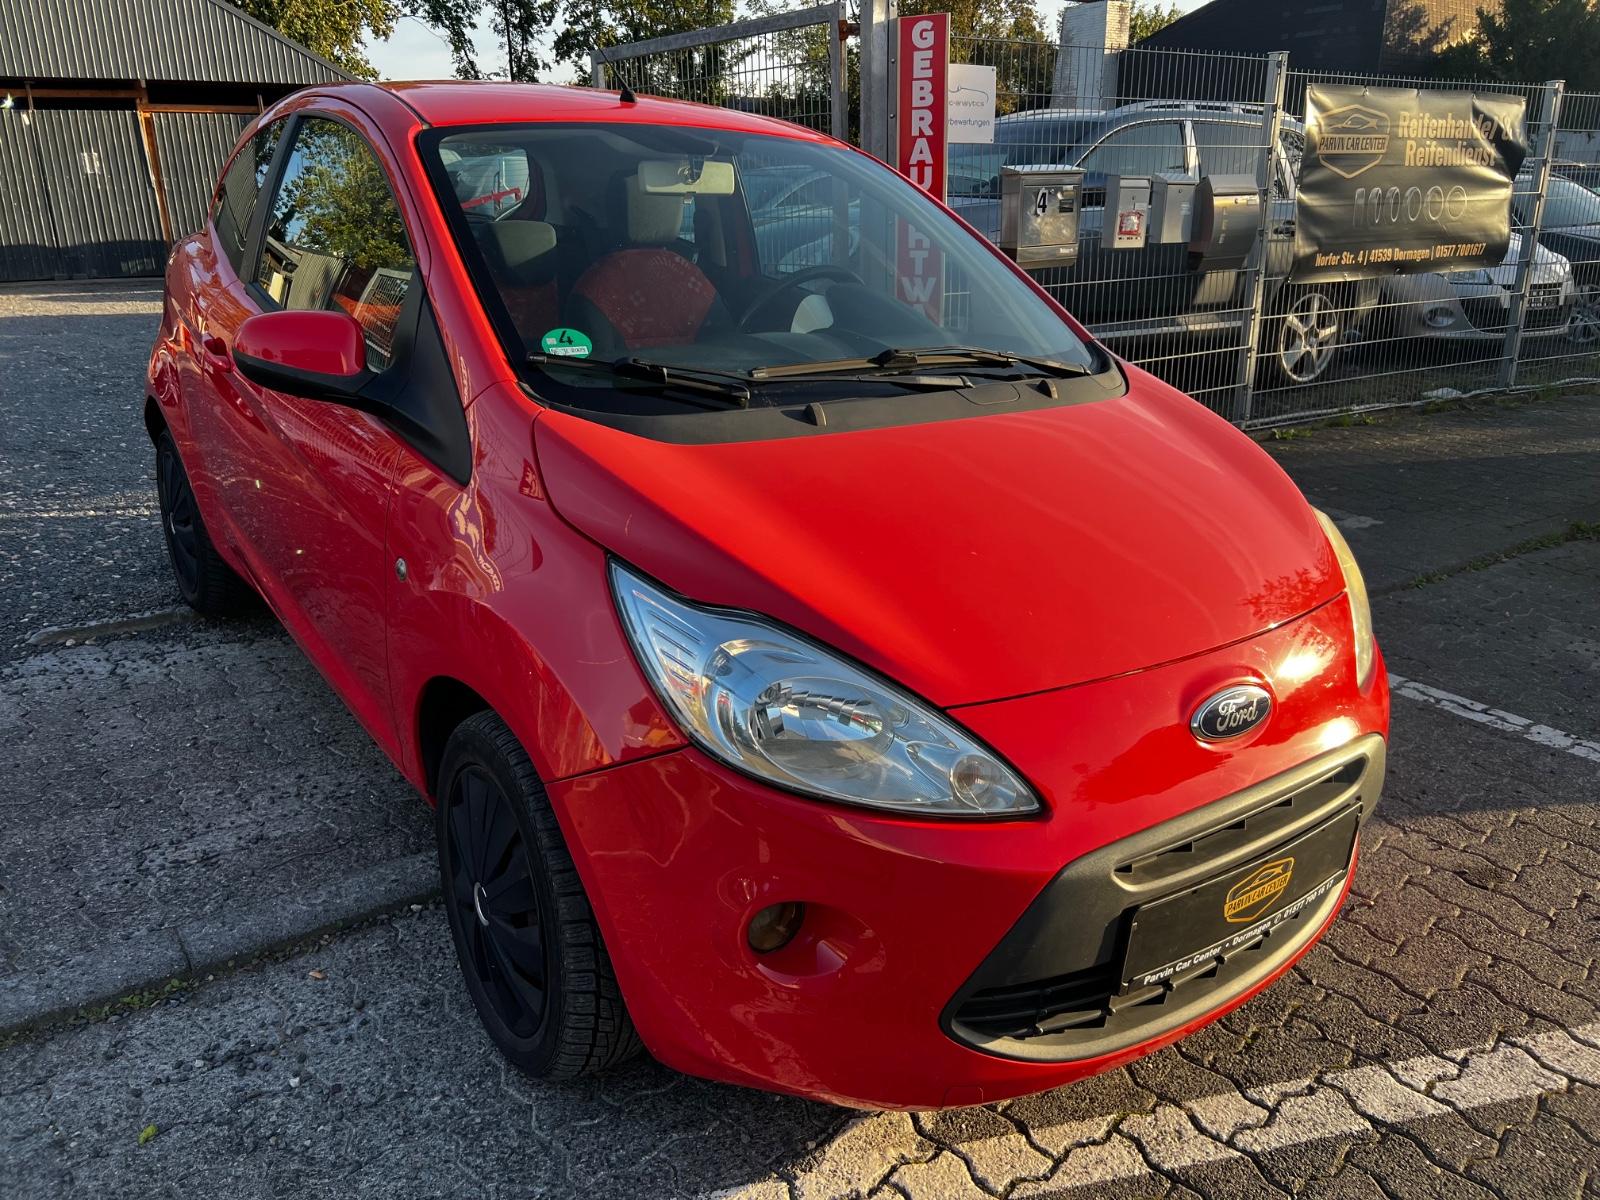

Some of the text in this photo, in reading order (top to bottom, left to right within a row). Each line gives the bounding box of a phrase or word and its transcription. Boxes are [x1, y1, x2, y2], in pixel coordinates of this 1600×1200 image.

[1398, 111, 1497, 140] Reifenhandel
[1319, 137, 1387, 151] PARVIN CAR CENTER
[1404, 140, 1496, 167] Reifendienst
[1037, 191, 1048, 213] 4
[1315, 252, 1340, 267] Norfer
[1341, 250, 1355, 265] Str.
[1358, 250, 1364, 264] 4
[1369, 248, 1392, 263] 41539
[1394, 247, 1430, 262] Dormagen
[1435, 244, 1457, 258] 01577
[558, 330, 574, 345] 4
[1216, 695, 1258, 731] Ford
[1143, 966, 1174, 985] Parvin
[1175, 959, 1192, 972] Car
[1193, 946, 1221, 964] Center
[1232, 921, 1272, 946] Dormagen
